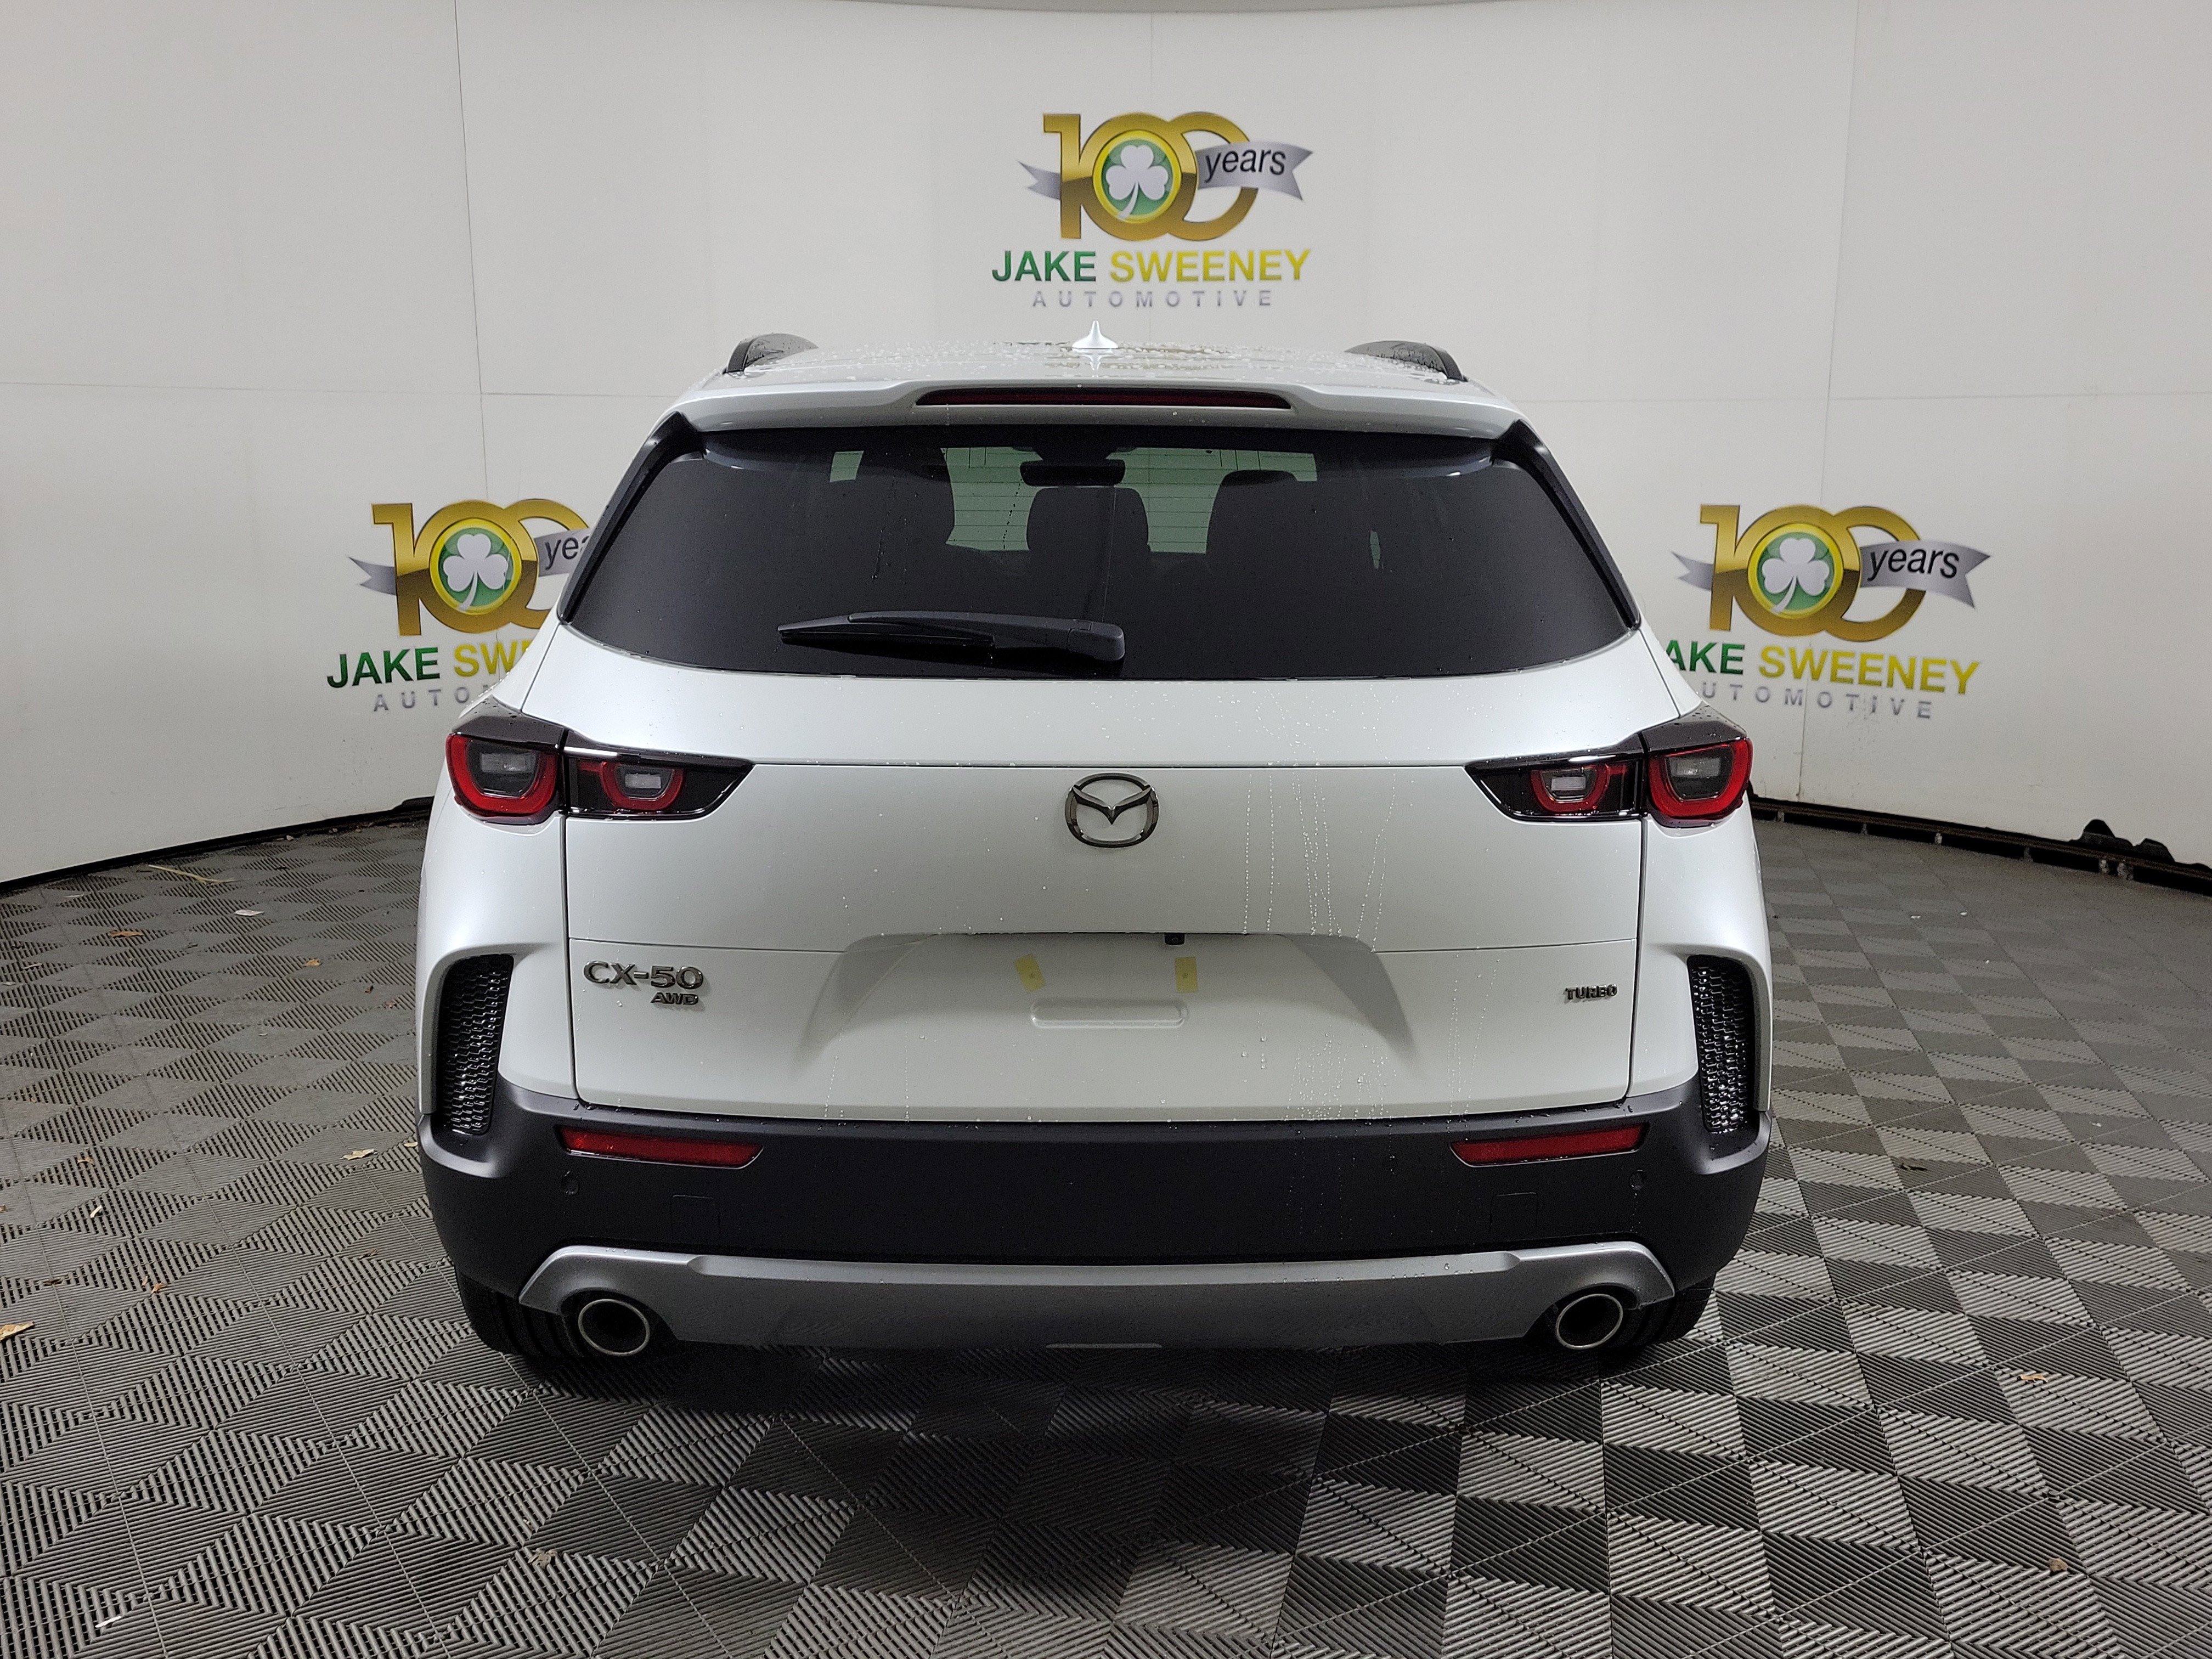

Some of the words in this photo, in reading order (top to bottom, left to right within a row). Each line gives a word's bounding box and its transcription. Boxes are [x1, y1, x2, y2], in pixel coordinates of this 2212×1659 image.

[1043, 111, 1259, 241] 100
[1204, 148, 1287, 183] years
[992, 250, 1096, 281] JAKE
[1110, 249, 1311, 282] SWEENEY
[1032, 290, 1272, 307] AUTOMOTIVE
[544, 535, 589, 570] ye
[1700, 504, 1926, 642] 100
[1867, 548, 1959, 581] years
[326, 647, 441, 689] JAKE
[454, 639, 536, 677] SW
[1758, 645, 1981, 696] SWEENEY
[373, 684, 488, 712] AUTO
[583, 960, 704, 990] CX-50
[651, 992, 699, 1005] AWD
[1565, 984, 1618, 1000] TURBO
